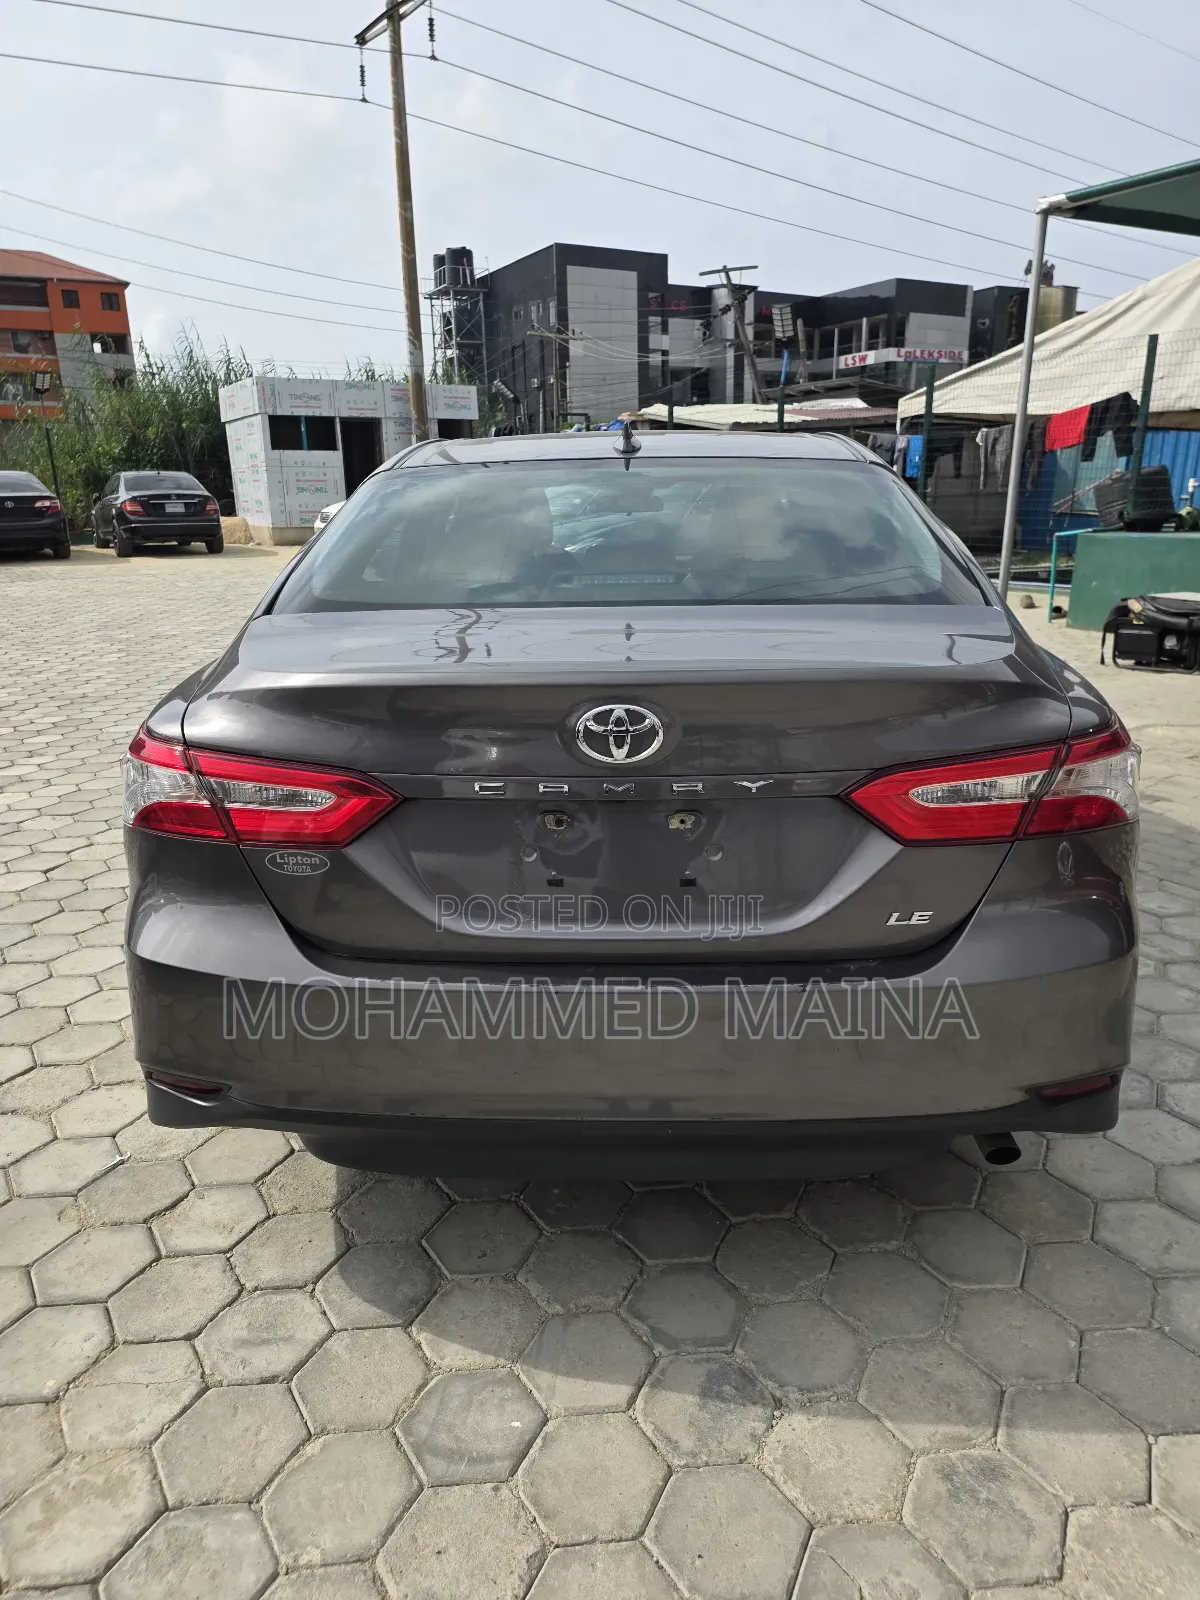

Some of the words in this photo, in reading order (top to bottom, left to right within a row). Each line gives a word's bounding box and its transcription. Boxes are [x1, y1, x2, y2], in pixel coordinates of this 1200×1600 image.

[844, 354, 868, 367] LSW
[474, 780, 774, 795] CAMRY
[276, 853, 320, 865] Lipton
[283, 864, 312, 873] TOYOTA
[885, 911, 934, 926] LE
